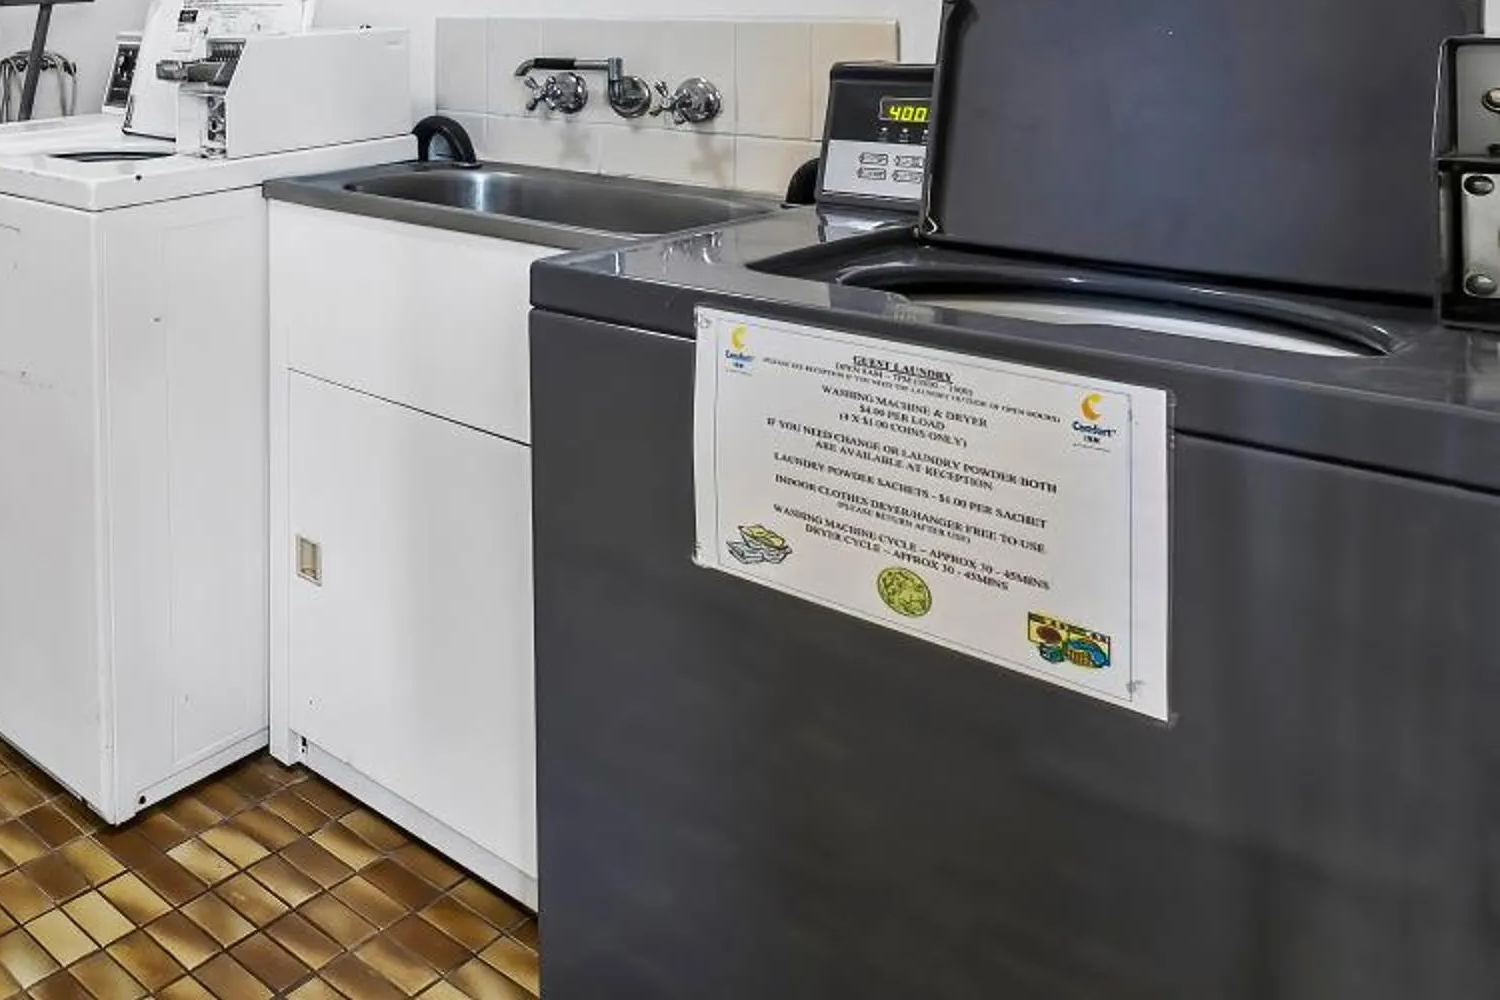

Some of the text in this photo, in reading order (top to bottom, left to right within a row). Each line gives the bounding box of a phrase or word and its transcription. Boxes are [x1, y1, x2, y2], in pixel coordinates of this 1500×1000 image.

[893, 362, 951, 383] LAUNDRY
[822, 384, 986, 427] WASHING MACHINE & DRYER
[859, 404, 944, 430] $4.00 PER LOAD
[767, 416, 1056, 493] IF YOU NEED CHANGE OR LAUNDRY POWDER BOTH
[890, 422, 924, 438] COINS
[928, 430, 966, 448] ONLY)
[773, 451, 824, 471] LAUNDRY
[827, 464, 874, 484] POWDER
[877, 477, 928, 498] SACHETS
[969, 500, 992, 515] PER
[995, 507, 1047, 529] SACHET
[816, 439, 992, 491] ARE AVAILABLE AT RECEPTION
[775, 473, 815, 492] INDOOR
[817, 484, 869, 506] CLOTHES
[965, 523, 996, 541] FREE
[999, 533, 1016, 546] TO
[1020, 538, 1044, 554] USE
[805, 522, 839, 541] DRYER
[844, 533, 880, 553] CYCLE
[893, 548, 938, 570] APPROX
[825, 517, 876, 541] MACHINE
[878, 532, 916, 552] CYCLE
[930, 547, 976, 569] APPROX
